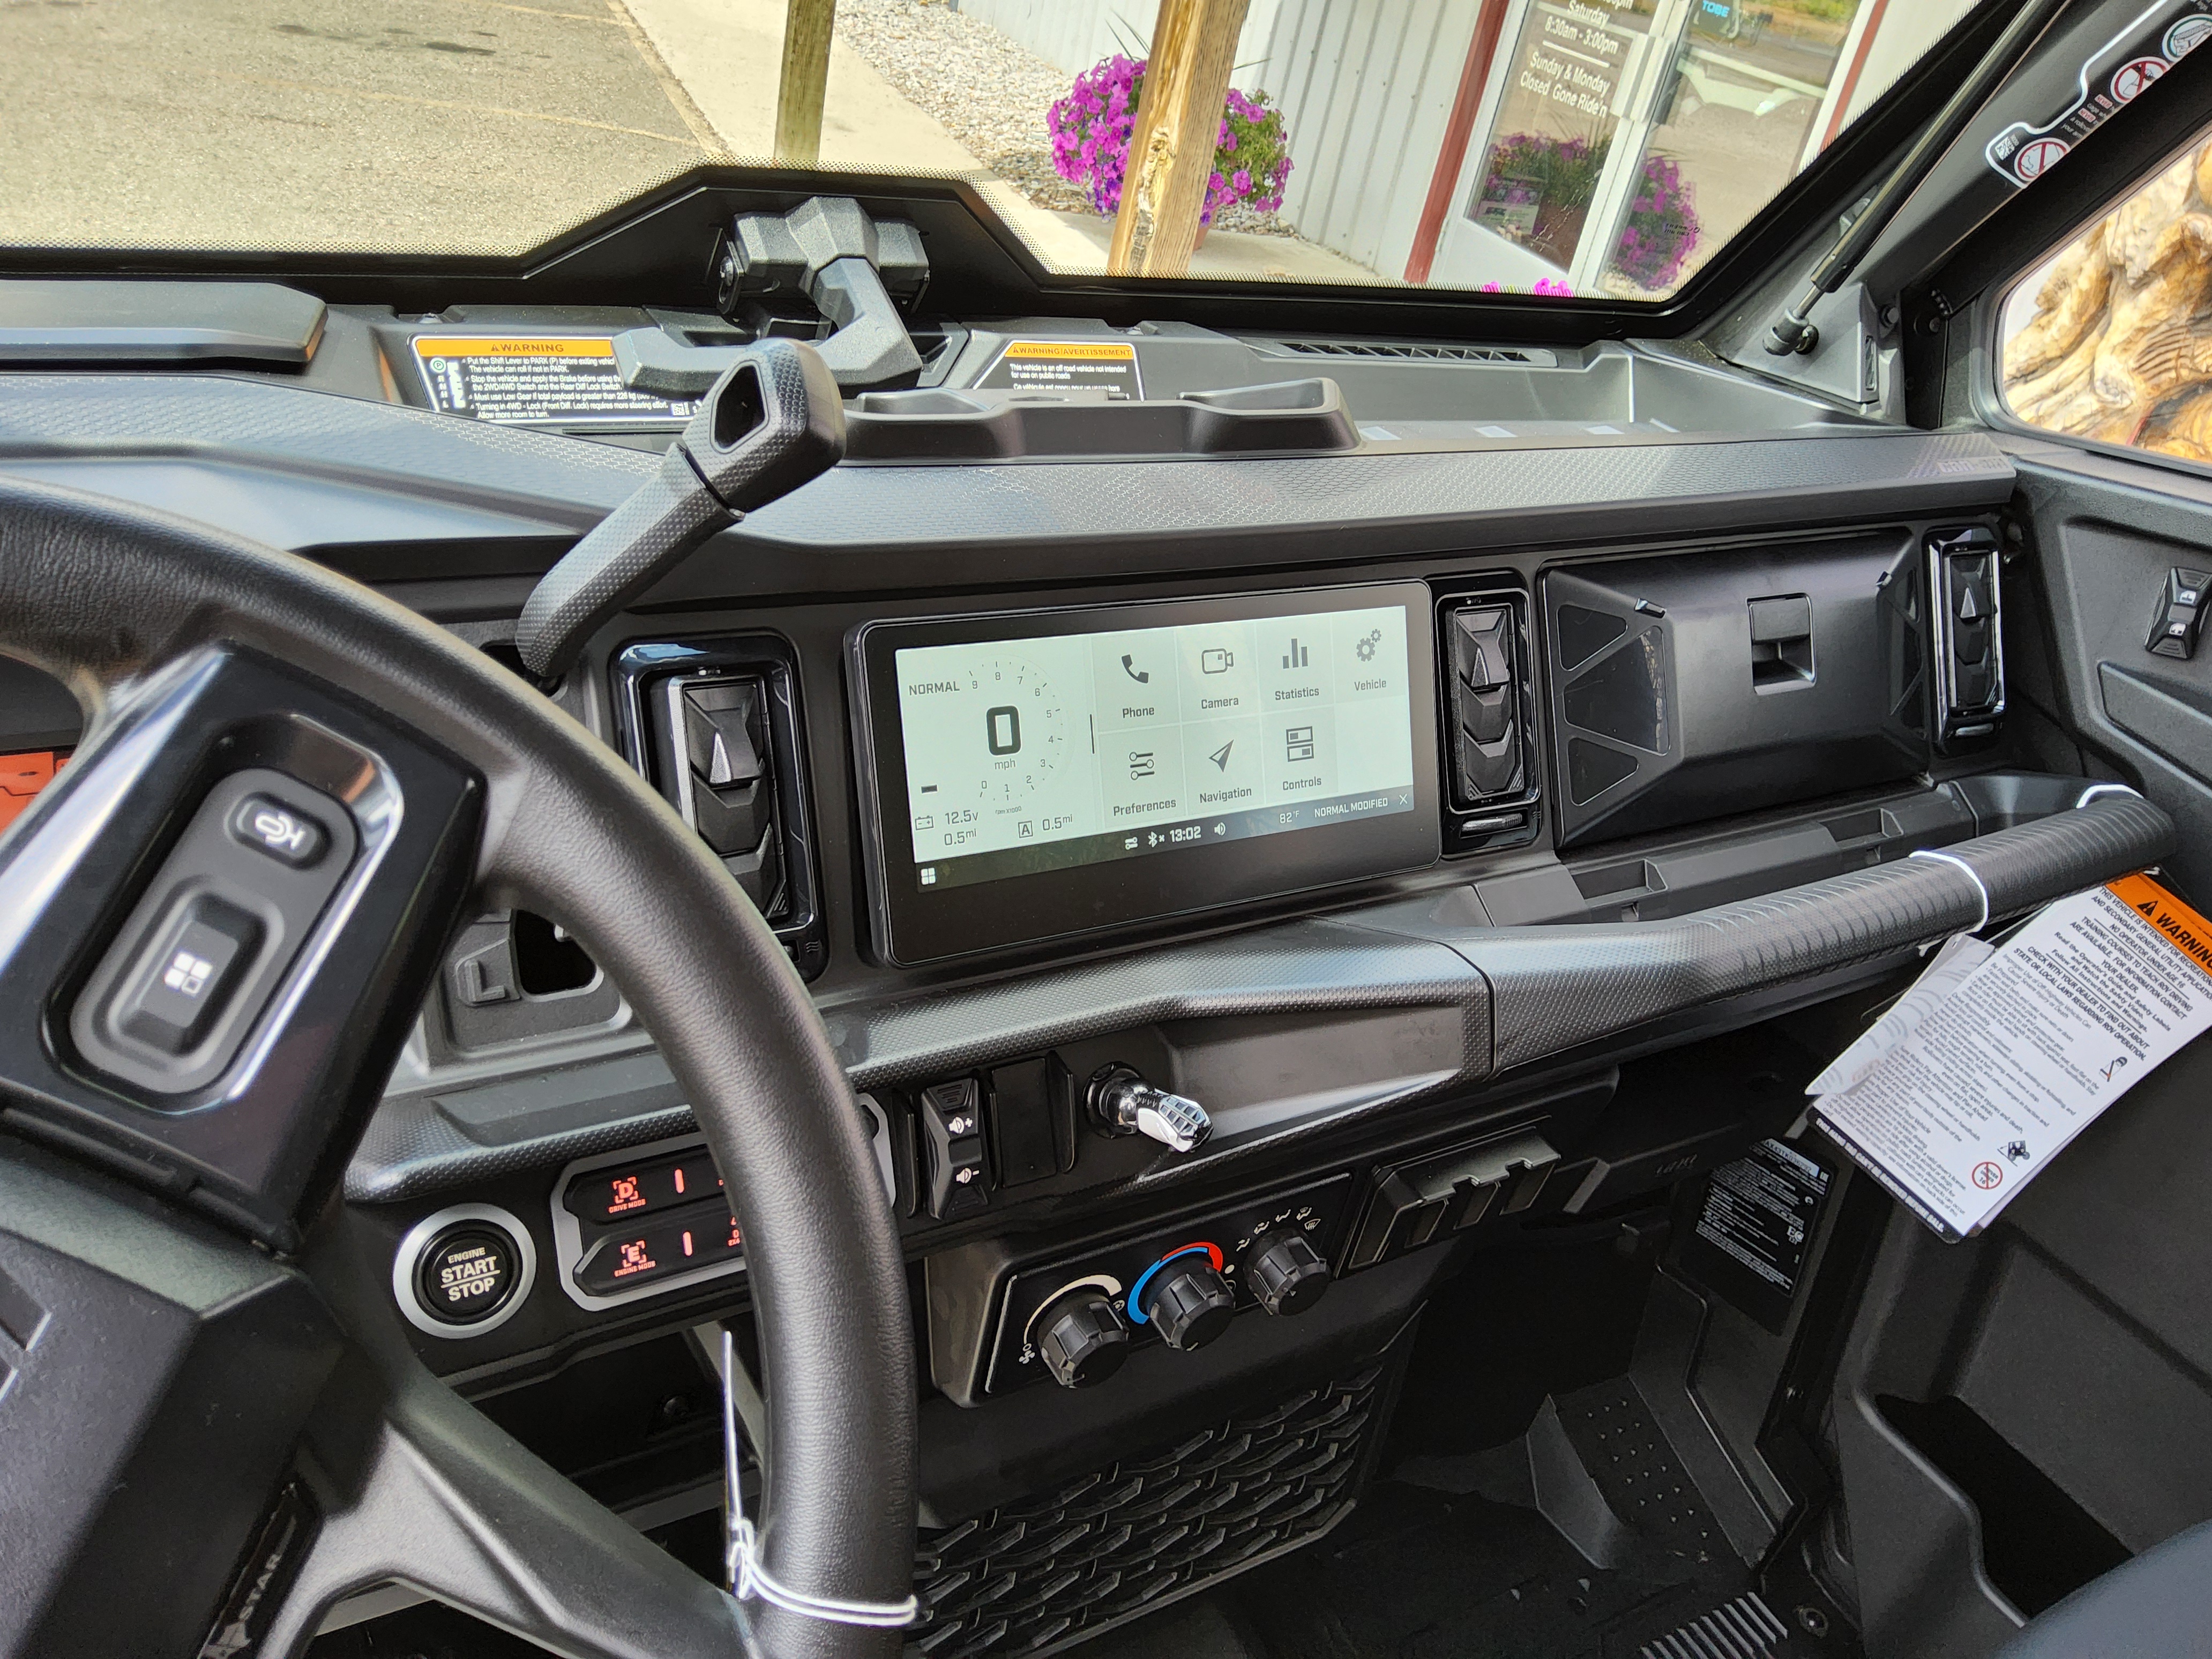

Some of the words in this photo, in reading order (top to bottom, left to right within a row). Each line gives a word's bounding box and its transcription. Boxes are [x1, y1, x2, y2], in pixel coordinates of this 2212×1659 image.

[1568, 0, 1610, 29] Saturday
[1583, 28, 1619, 55] 3:00pm
[1530, 51, 1564, 80] Sunday
[1564, 64, 1573, 80] &
[1573, 66, 1610, 98] Monday
[1520, 70, 1551, 96] Closed
[1553, 84, 1578, 107] Gone
[1577, 93, 1608, 119] Ride'n
[500, 343, 564, 352] WARNING
[1020, 348, 1131, 356] WARNING/AVERTISSEMENT
[578, 358, 597, 366] exiting
[471, 375, 485, 383] Stop
[532, 375, 548, 383] apply
[597, 375, 612, 383] using
[909, 681, 960, 695] NORMAL
[972, 680, 978, 689] 9
[995, 671, 1001, 681] 8
[1017, 676, 1023, 685] 7
[1034, 688, 1040, 697] 6
[1354, 678, 1387, 691] Vehicle
[1275, 687, 1319, 700] Statistics
[1122, 705, 1155, 719] Phone
[1201, 696, 1239, 710] Camera
[987, 706, 1021, 756] 0
[1046, 709, 1052, 718] 5
[1048, 735, 1053, 744] 4
[994, 759, 1016, 771] mph
[1040, 759, 1046, 768] 3
[981, 780, 987, 789] 0
[1004, 784, 1010, 793] 1
[1026, 775, 1032, 784] 2
[1282, 776, 1322, 791] Controls
[1199, 786, 1252, 804] Navigation
[1114, 798, 1176, 817] Preferences
[1170, 826, 1201, 843] 13:02
[1314, 804, 1349, 818] NORMAL
[1350, 797, 1388, 813] MODIFIED
[2099, 887, 2113, 900] THIS
[2111, 899, 2136, 920] VEHICLE
[2140, 923, 2169, 947] INTENDED
[2167, 946, 2180, 957] FOR
[2091, 895, 2105, 907] AND
[2103, 905, 2138, 934] SECONDARY
[2135, 932, 2162, 955] GENERAL
[2160, 954, 2183, 973] UTILITY
[2081, 917, 2109, 940] TRAINING
[2106, 938, 2134, 961] COURSES
[2131, 959, 2142, 968] TO
[2139, 966, 2159, 983] TEACH
[2157, 981, 2171, 993] ROV
[2169, 991, 2193, 1012] DRIVING
[2109, 923, 2120, 932] NO
[2118, 931, 2149, 957] OPERATOR
[2146, 955, 2167, 973] UNDER
[2164, 971, 2178, 983] AGE
[2176, 980, 2185, 988] 16
[2069, 921, 2083, 932] ARE
[2081, 930, 2113, 957] AVAILABLE.
[2112, 956, 2126, 969] FOR
[2124, 967, 2162, 999] INFORMATION
[2159, 997, 2187, 1020] CONTACT
[2100, 960, 2118, 974] YOUR
[2116, 973, 2140, 993] DEALER.
[2013, 947, 2032, 963] STATE
[2030, 961, 2041, 970] OR
[2038, 968, 2059, 985] LOCAL
[2056, 983, 2074, 998] LAWS
[2071, 996, 2104, 1024] REGARDING
[2102, 1022, 2116, 1034] ROV
[2112, 1032, 2147, 1060] OPERATION.
[2027, 946, 2048, 963] CHECK
[2045, 961, 2062, 976] WITH
[2060, 974, 2078, 989] YOUR
[2075, 987, 2098, 1006] DEALER
[2096, 1004, 2106, 1013] TO
[2103, 1011, 2119, 1023] FIND
[2116, 1021, 2131, 1033] OUT
[2128, 1031, 2149, 1050] ABOUT
[618, 1182, 634, 1199] D
[609, 1204, 627, 1214] DRIVE
[628, 1198, 646, 1209] MODE
[447, 1247, 485, 1264] ENGINE
[627, 1245, 640, 1262] E
[441, 1256, 497, 1284] START
[614, 1265, 638, 1277] ENGINE
[638, 1260, 656, 1271] MODE
[447, 1277, 495, 1301] STOP
